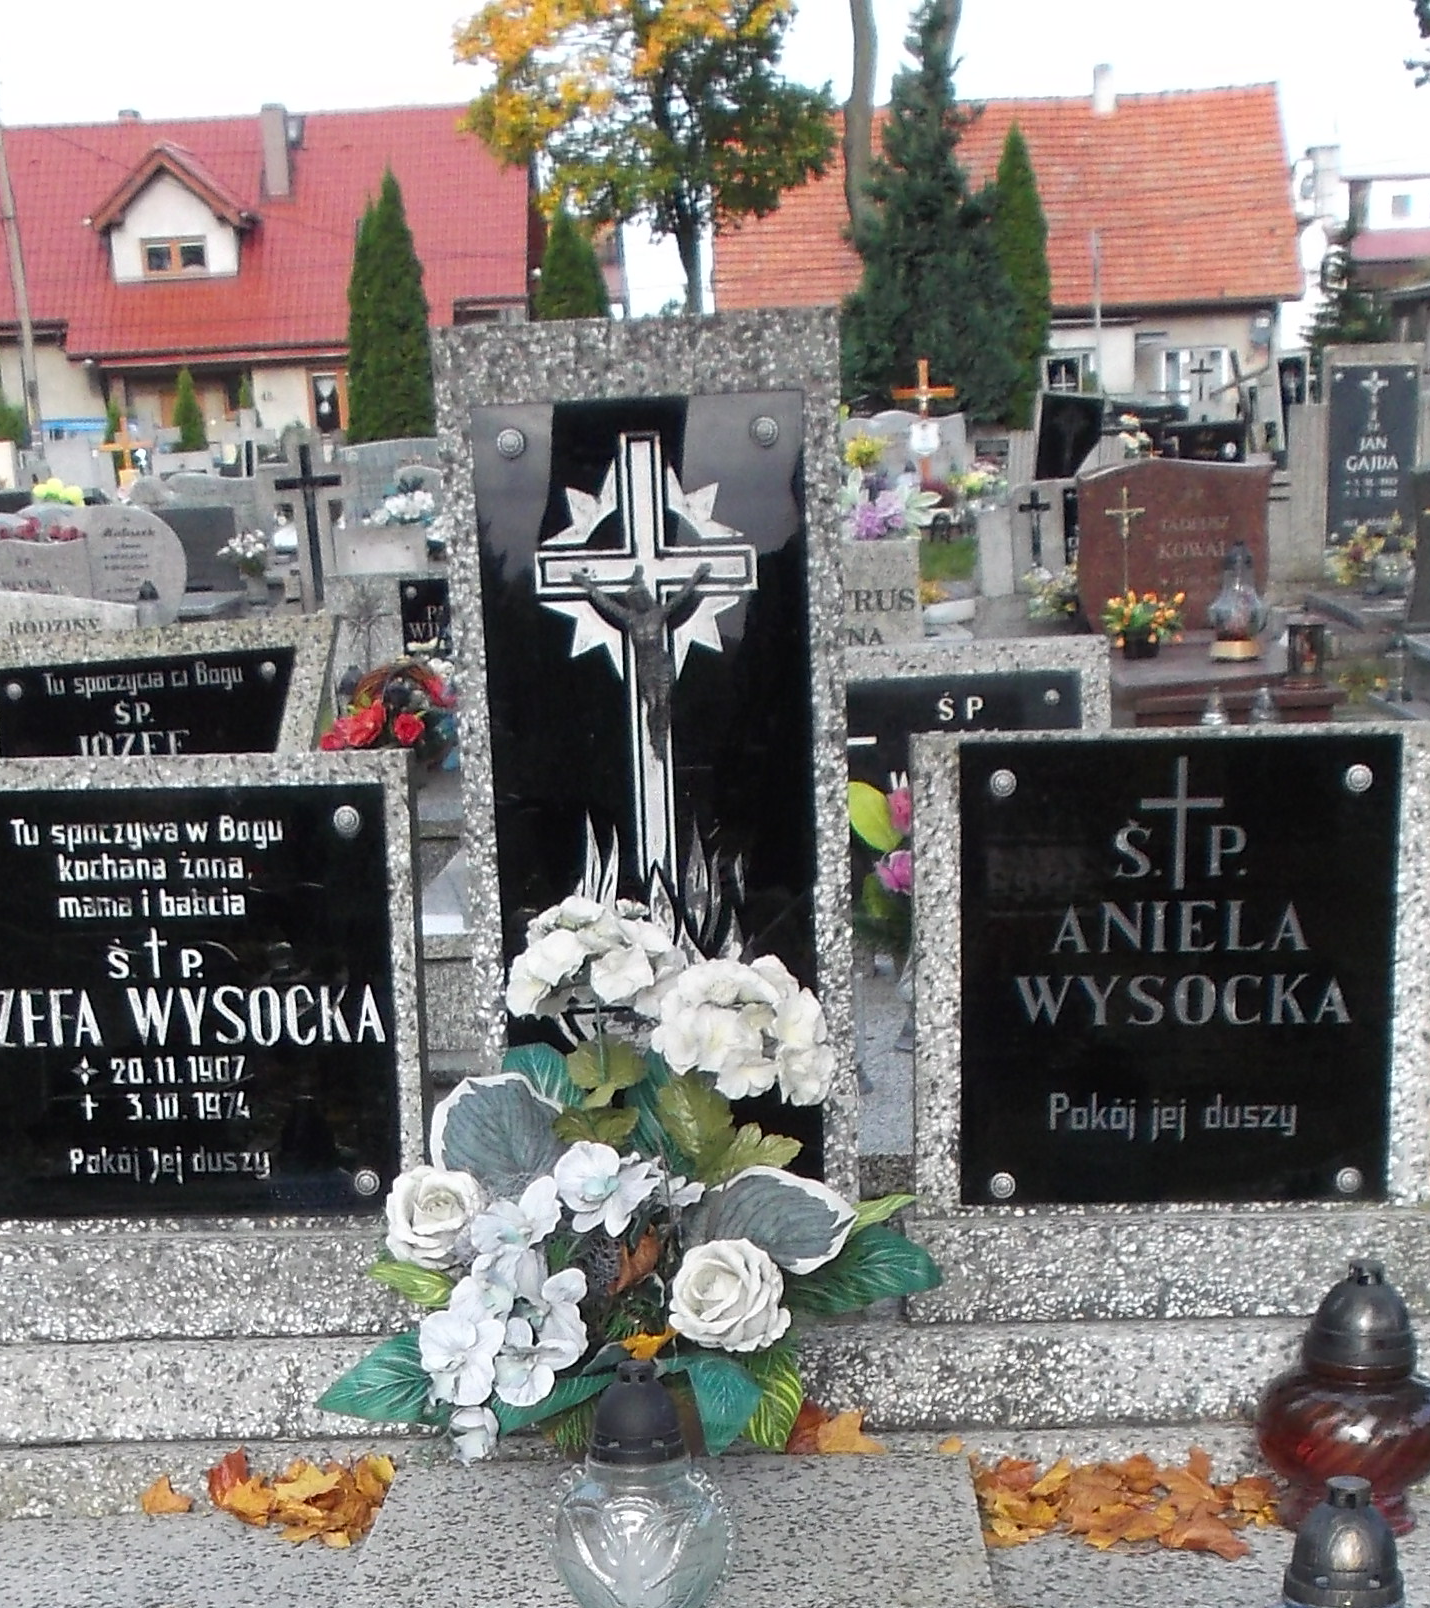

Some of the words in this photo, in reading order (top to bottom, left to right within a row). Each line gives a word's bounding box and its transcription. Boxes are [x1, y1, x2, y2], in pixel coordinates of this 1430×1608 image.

[1359, 436, 1389, 451] JAN
[1345, 455, 1399, 473] GAJDA
[43, 671, 65, 697] Tu
[195, 660, 244, 690] Bogu
[10, 818, 40, 847] Tu
[50, 819, 179, 852] spoczywa
[185, 821, 209, 843] w
[219, 814, 284, 849] Bogu
[1207, 825, 1249, 878] P.
[58, 853, 168, 882] kochana
[58, 896, 133, 918] mama
[142, 888, 150, 917] i
[159, 887, 246, 917] babcia
[1050, 901, 1311, 955] ANIELA
[126, 983, 387, 1047] WYSOCKA
[1013, 974, 1353, 1027] WYSOCKA
[110, 1055, 246, 1084] 20.11.1907
[126, 1090, 251, 1121] 3.10.1974
[1049, 1092, 1136, 1141] Pokój
[1151, 1096, 1187, 1142] jej
[1204, 1092, 1299, 1137] duszy
[69, 1146, 141, 1183] Pokój
[192, 1146, 271, 1180] duszy
